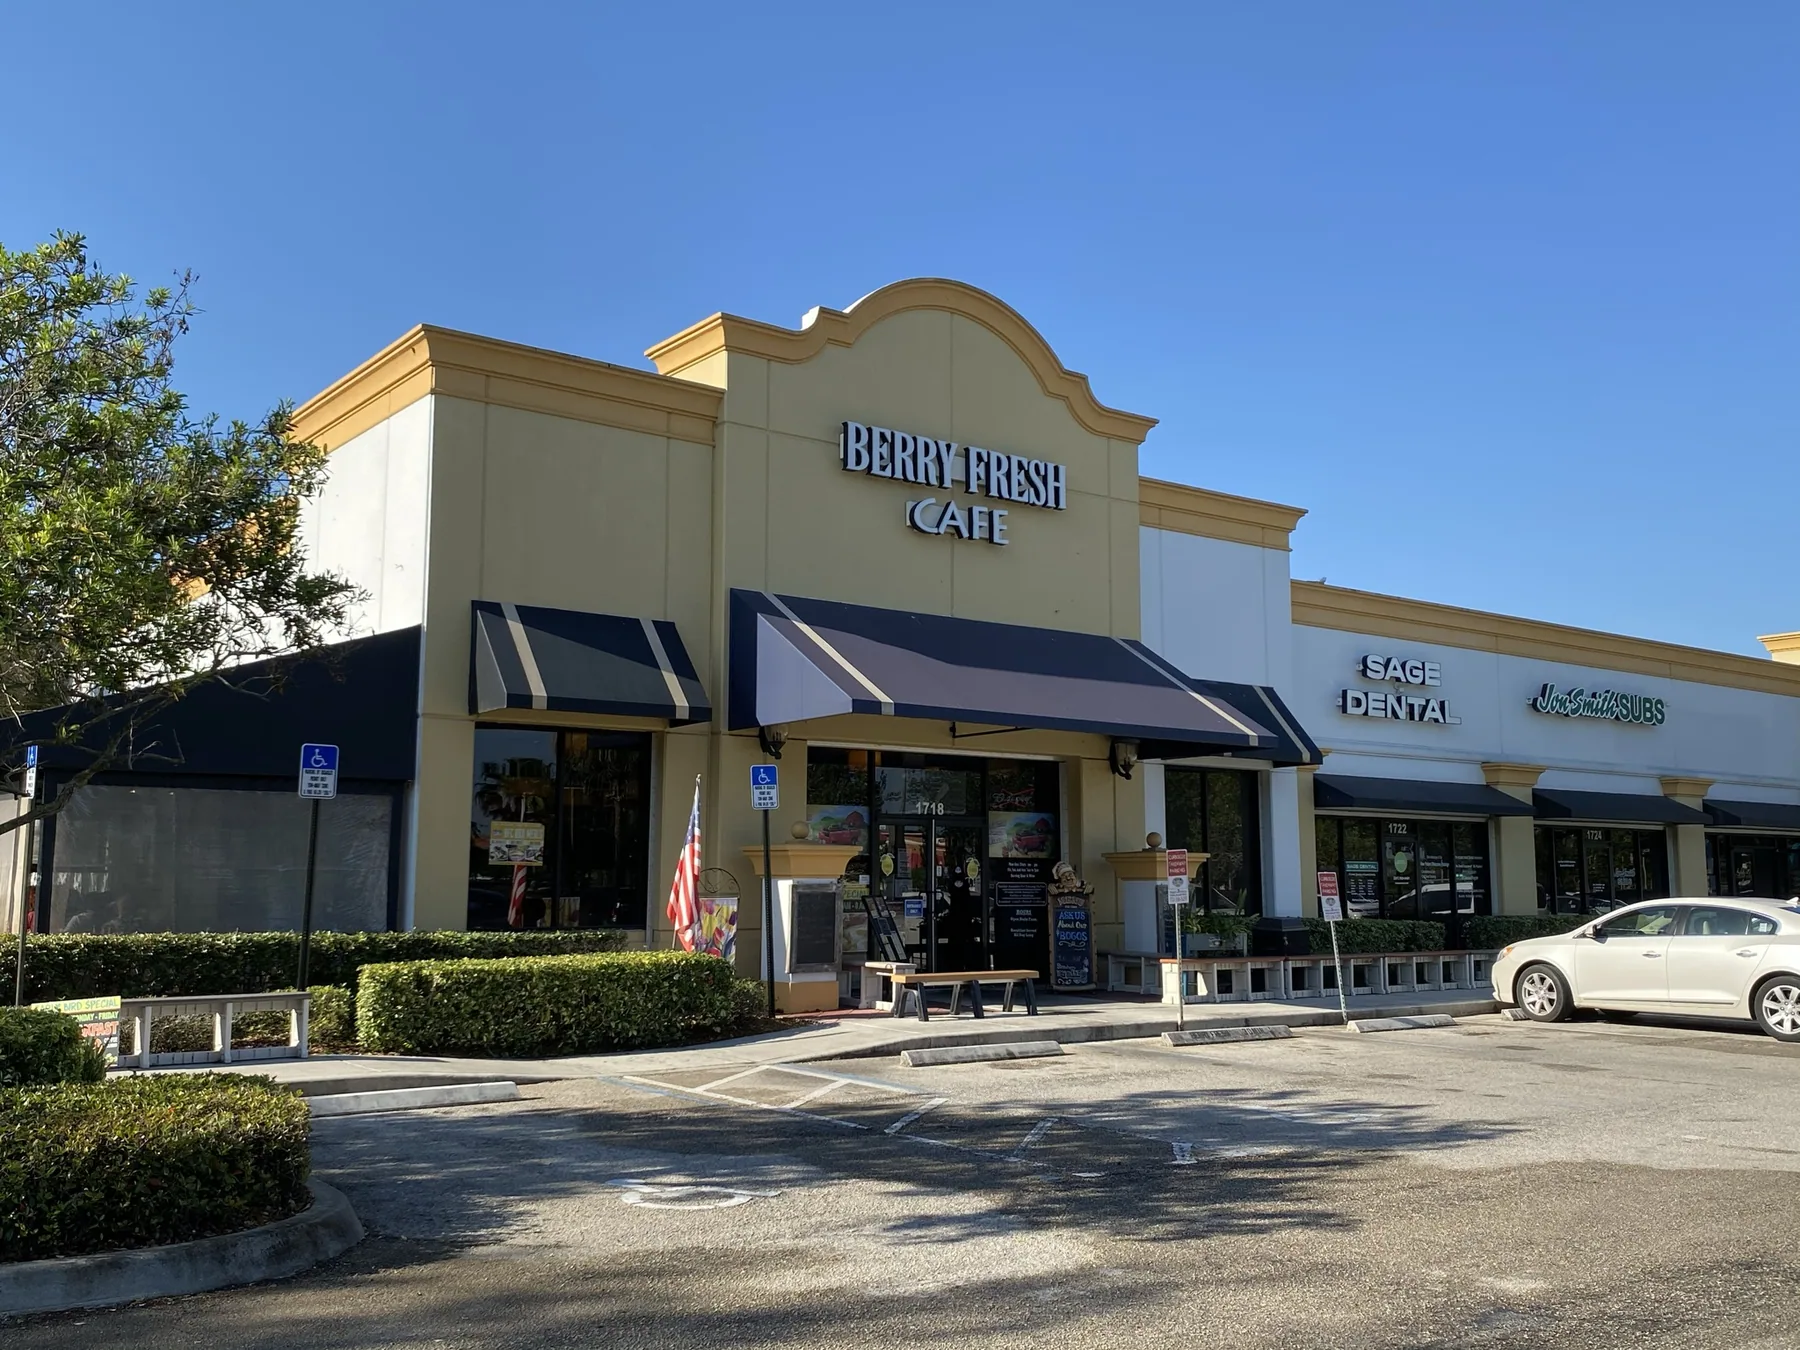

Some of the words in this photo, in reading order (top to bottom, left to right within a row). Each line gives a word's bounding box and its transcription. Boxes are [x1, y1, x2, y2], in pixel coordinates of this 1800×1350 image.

[843, 421, 958, 489] BERRY
[965, 446, 1067, 510] FRESH
[911, 498, 1009, 545] CAFE
[1363, 654, 1441, 687] SAGE
[1343, 690, 1462, 724] DENTAL
[1569, 688, 1618, 718] Smith
[1617, 693, 1666, 725] SUBS
[915, 802, 944, 816] 1718
[1388, 823, 1407, 834] 1722
[1587, 829, 1602, 840] 1724
[1075, 911, 1085, 920] US
[1075, 921, 1087, 929] Our
[1060, 931, 1088, 941] BOGOS
[64, 1001, 82, 1012] BIRD
[85, 998, 118, 1010] SPECIAL
